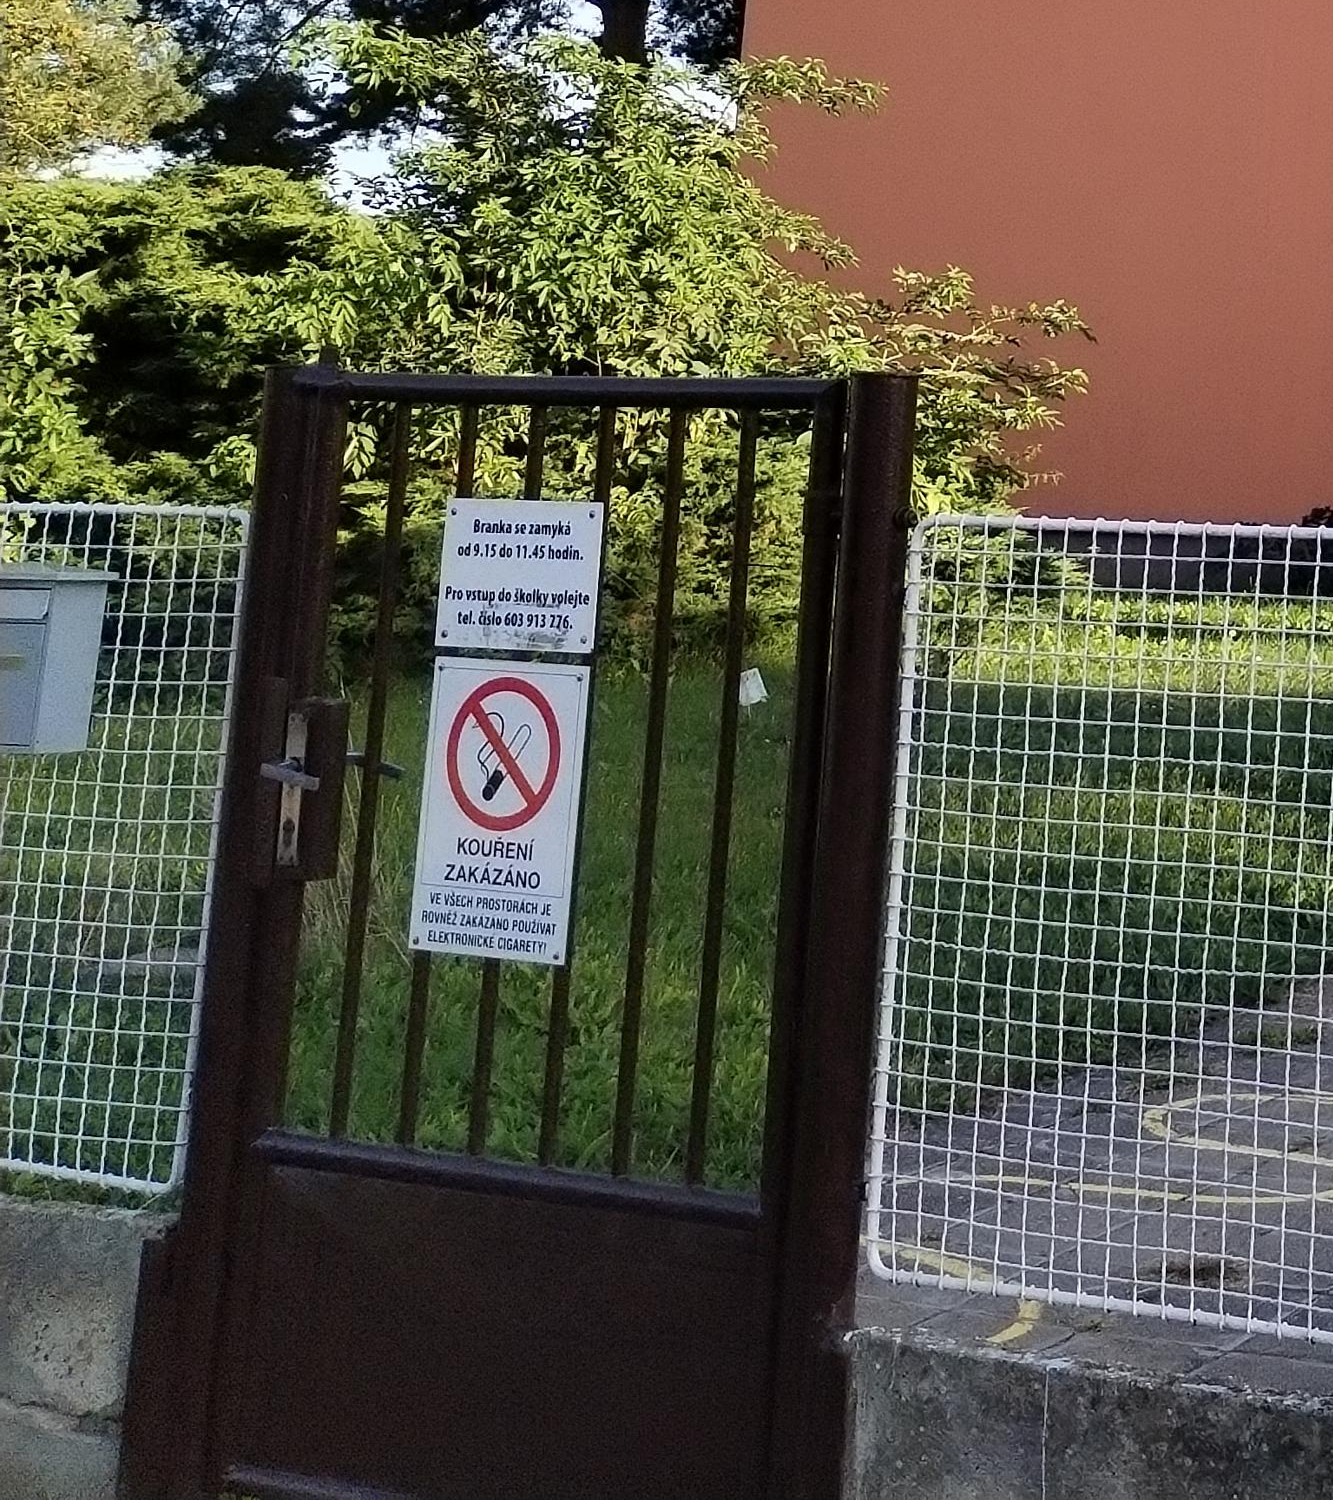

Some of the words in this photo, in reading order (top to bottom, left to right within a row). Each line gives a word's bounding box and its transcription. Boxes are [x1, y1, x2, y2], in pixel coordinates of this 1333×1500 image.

[473, 518, 512, 534] Branka
[515, 523, 527, 535] se
[529, 520, 571, 539] zamyká
[457, 542, 471, 557] od
[473, 543, 497, 558] 9.15
[499, 543, 513, 558] do
[516, 544, 545, 560] 11.45
[548, 544, 584, 561] hodin.
[445, 585, 464, 601] Pro
[465, 589, 496, 606] vstup
[498, 587, 512, 603] do
[514, 587, 549, 608] školky
[551, 589, 590, 609] volejte
[457, 610, 476, 625] tel.
[479, 610, 502, 626] číslo
[504, 611, 524, 628] 603
[526, 613, 547, 629] 913
[456, 836, 535, 861] KOUŘENÍ
[444, 861, 541, 889] ZAKÁZÁNO
[430, 892, 442, 905] VE
[444, 891, 473, 909] VŠECH
[476, 898, 538, 916] PROSTORÁCH
[541, 903, 552, 916] JE
[511, 917, 557, 936] POUŽÍVAT
[497, 937, 547, 955] CIGARETY!
